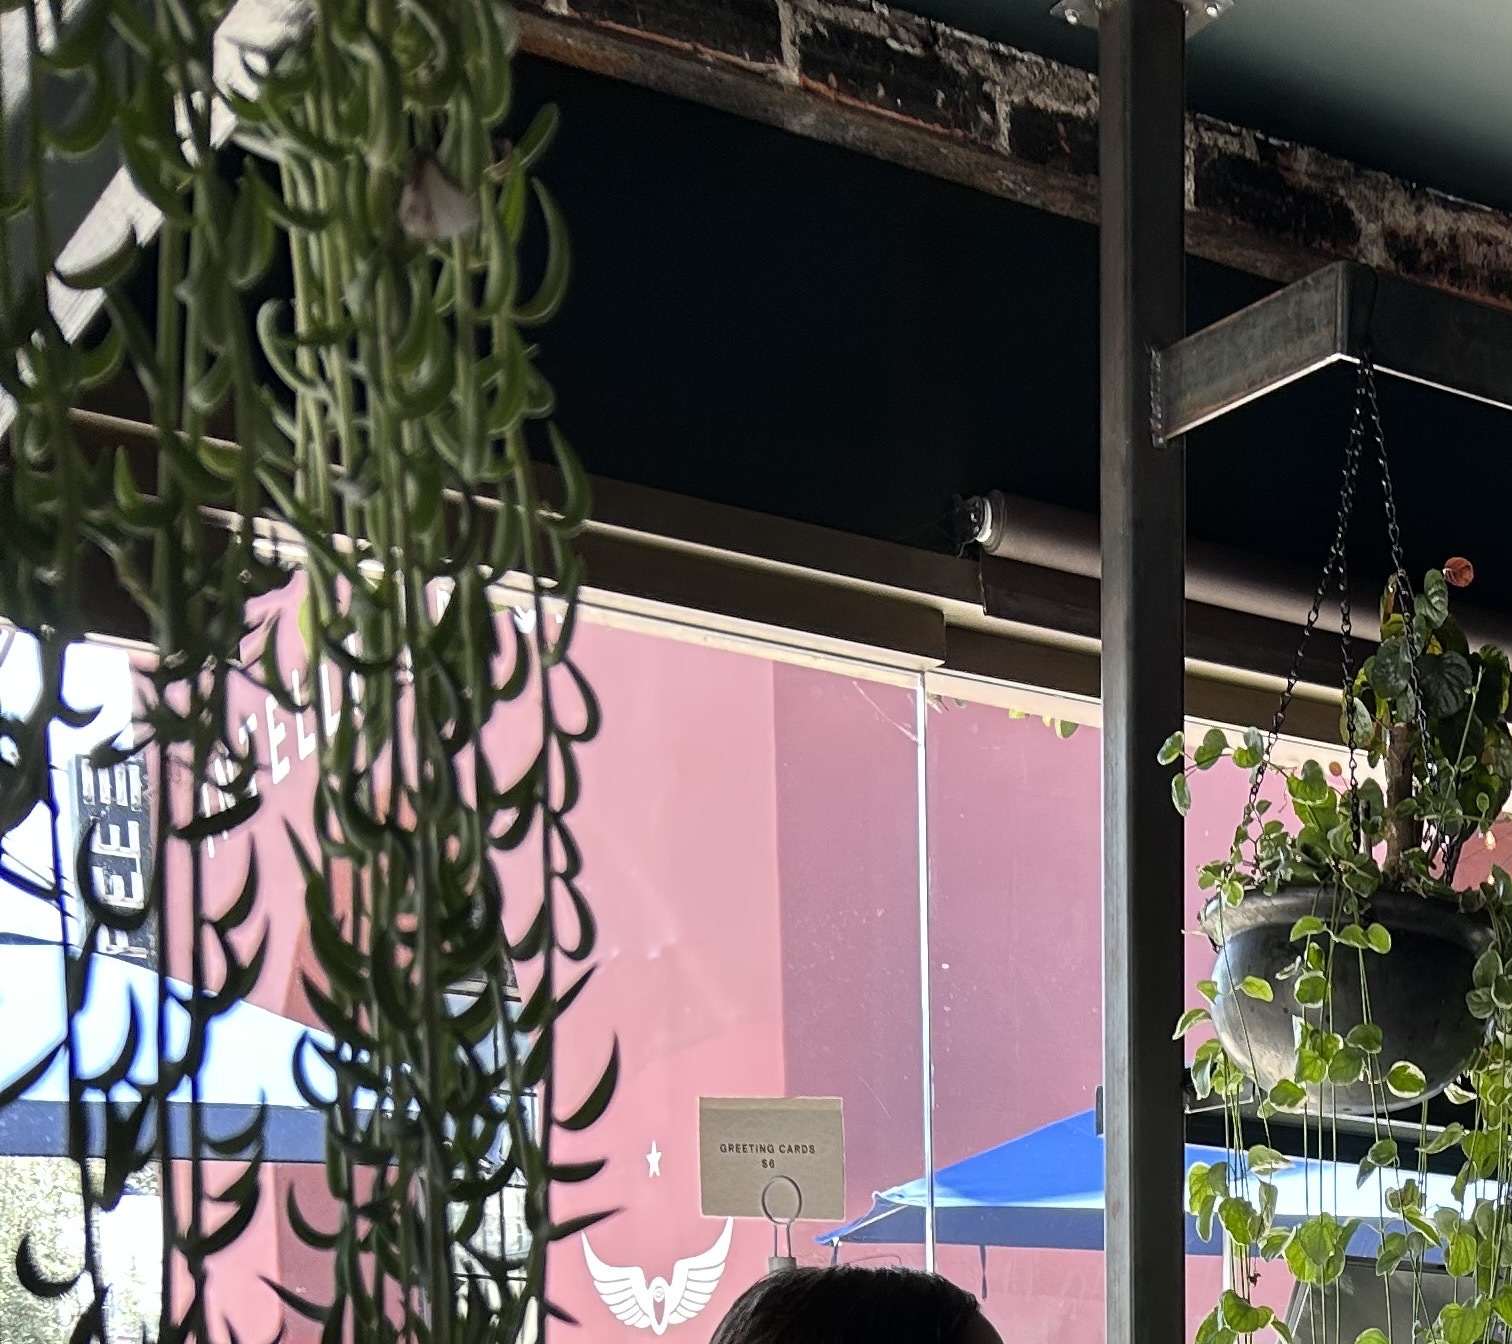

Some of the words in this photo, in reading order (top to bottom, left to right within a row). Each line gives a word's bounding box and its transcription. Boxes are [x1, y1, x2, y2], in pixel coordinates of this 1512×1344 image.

[720, 1143, 775, 1154] GREETING
[778, 1144, 816, 1155] CARDS
[761, 1158, 775, 1168] $6
